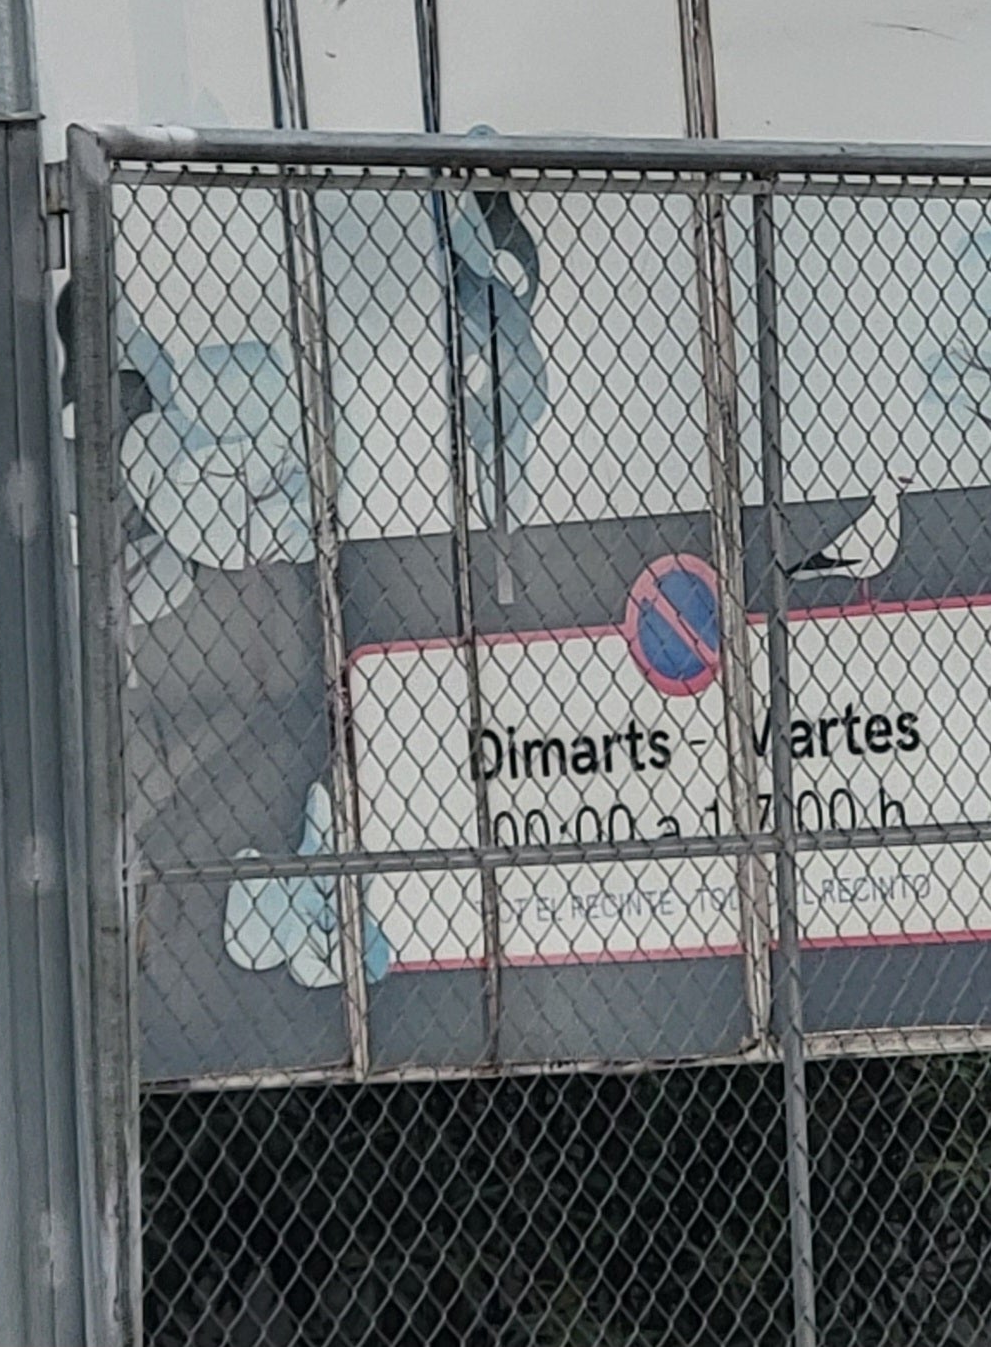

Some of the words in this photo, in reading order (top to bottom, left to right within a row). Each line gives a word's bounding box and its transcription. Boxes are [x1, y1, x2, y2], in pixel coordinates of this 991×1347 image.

[470, 719, 672, 781] Dimarts
[704, 788, 856, 837] 1700
[822, 872, 931, 903] RECINTO
